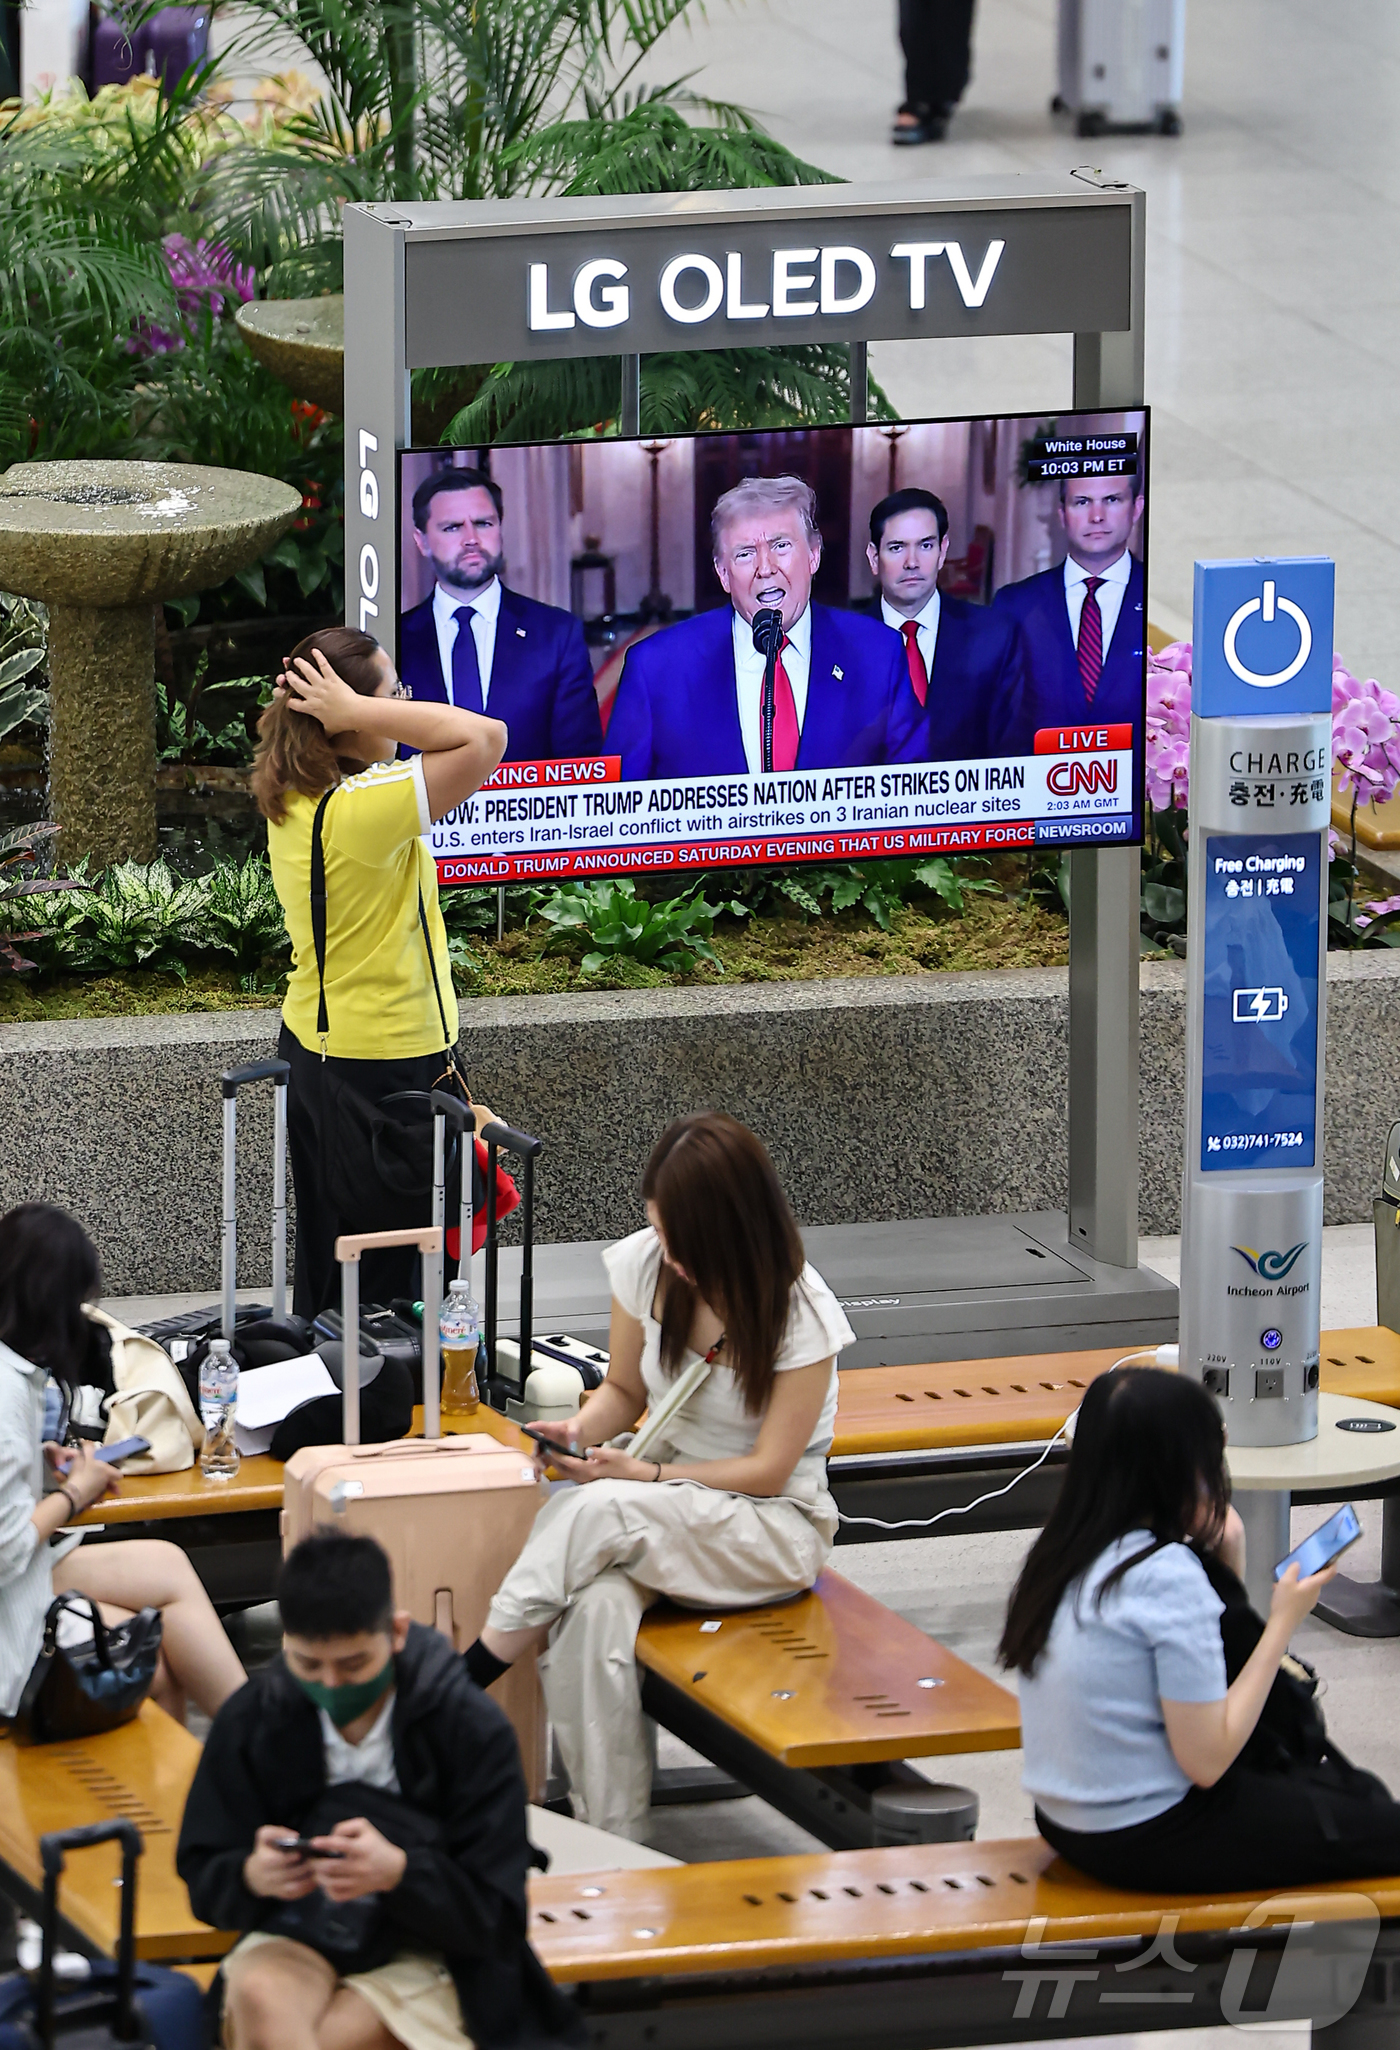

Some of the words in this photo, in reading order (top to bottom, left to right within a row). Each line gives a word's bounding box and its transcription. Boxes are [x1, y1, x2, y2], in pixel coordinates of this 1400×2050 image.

[527, 258, 631, 331] LG
[658, 245, 877, 324] OLED
[888, 238, 1006, 309] TV
[1045, 440, 1083, 453] White
[1086, 439, 1126, 451] House
[358, 428, 379, 521] LG
[1041, 461, 1079, 475] 10:03
[1083, 460, 1104, 473] PM
[1108, 459, 1126, 471] ET
[1059, 730, 1109, 749] LIVE
[1229, 747, 1325, 774] CHARGE
[545, 762, 607, 782] NEWS
[1046, 759, 1118, 796] CNN
[485, 794, 578, 823] PRESIDENT
[583, 790, 643, 817] TRUMP
[648, 783, 748, 813] ADDRESSES
[754, 779, 817, 806] NATION
[822, 775, 875, 801] AFTER
[881, 770, 950, 798] STRIKES
[955, 768, 979, 793] ON
[985, 766, 1024, 791] IRAN
[1047, 801, 1070, 811] 2:03
[1072, 799, 1091, 809] AM
[1094, 797, 1119, 808] GMT
[432, 831, 466, 848] U.S.
[471, 829, 525, 846] enters
[530, 822, 614, 842] Iran-Israel
[619, 817, 682, 836] conflict
[686, 814, 723, 832] with
[728, 810, 805, 829] airstrikes
[810, 810, 830, 824] on
[836, 806, 847, 822] 3
[852, 803, 909, 821] Iranian
[914, 799, 977, 817] nuclear
[981, 796, 1021, 813] sites
[1038, 821, 1127, 838] NEWSROOM
[443, 861, 510, 878] DONALD
[513, 856, 570, 873] TRUMP
[573, 850, 675, 870] ANNOUNCED
[678, 844, 763, 862] SATURDAY
[766, 838, 835, 858] EVENING
[838, 836, 880, 852] THAT
[883, 834, 905, 849] US
[908, 829, 981, 848] MILITARY
[985, 826, 1035, 842] FORCE
[1214, 856, 1243, 874] Free
[1245, 854, 1305, 873] Charging
[1222, 1132, 1303, 1150] 032)741-7524
[1227, 1285, 1273, 1297] Incheon
[1276, 1283, 1310, 1297] Airport
[1260, 1357, 1281, 1365] 110V
